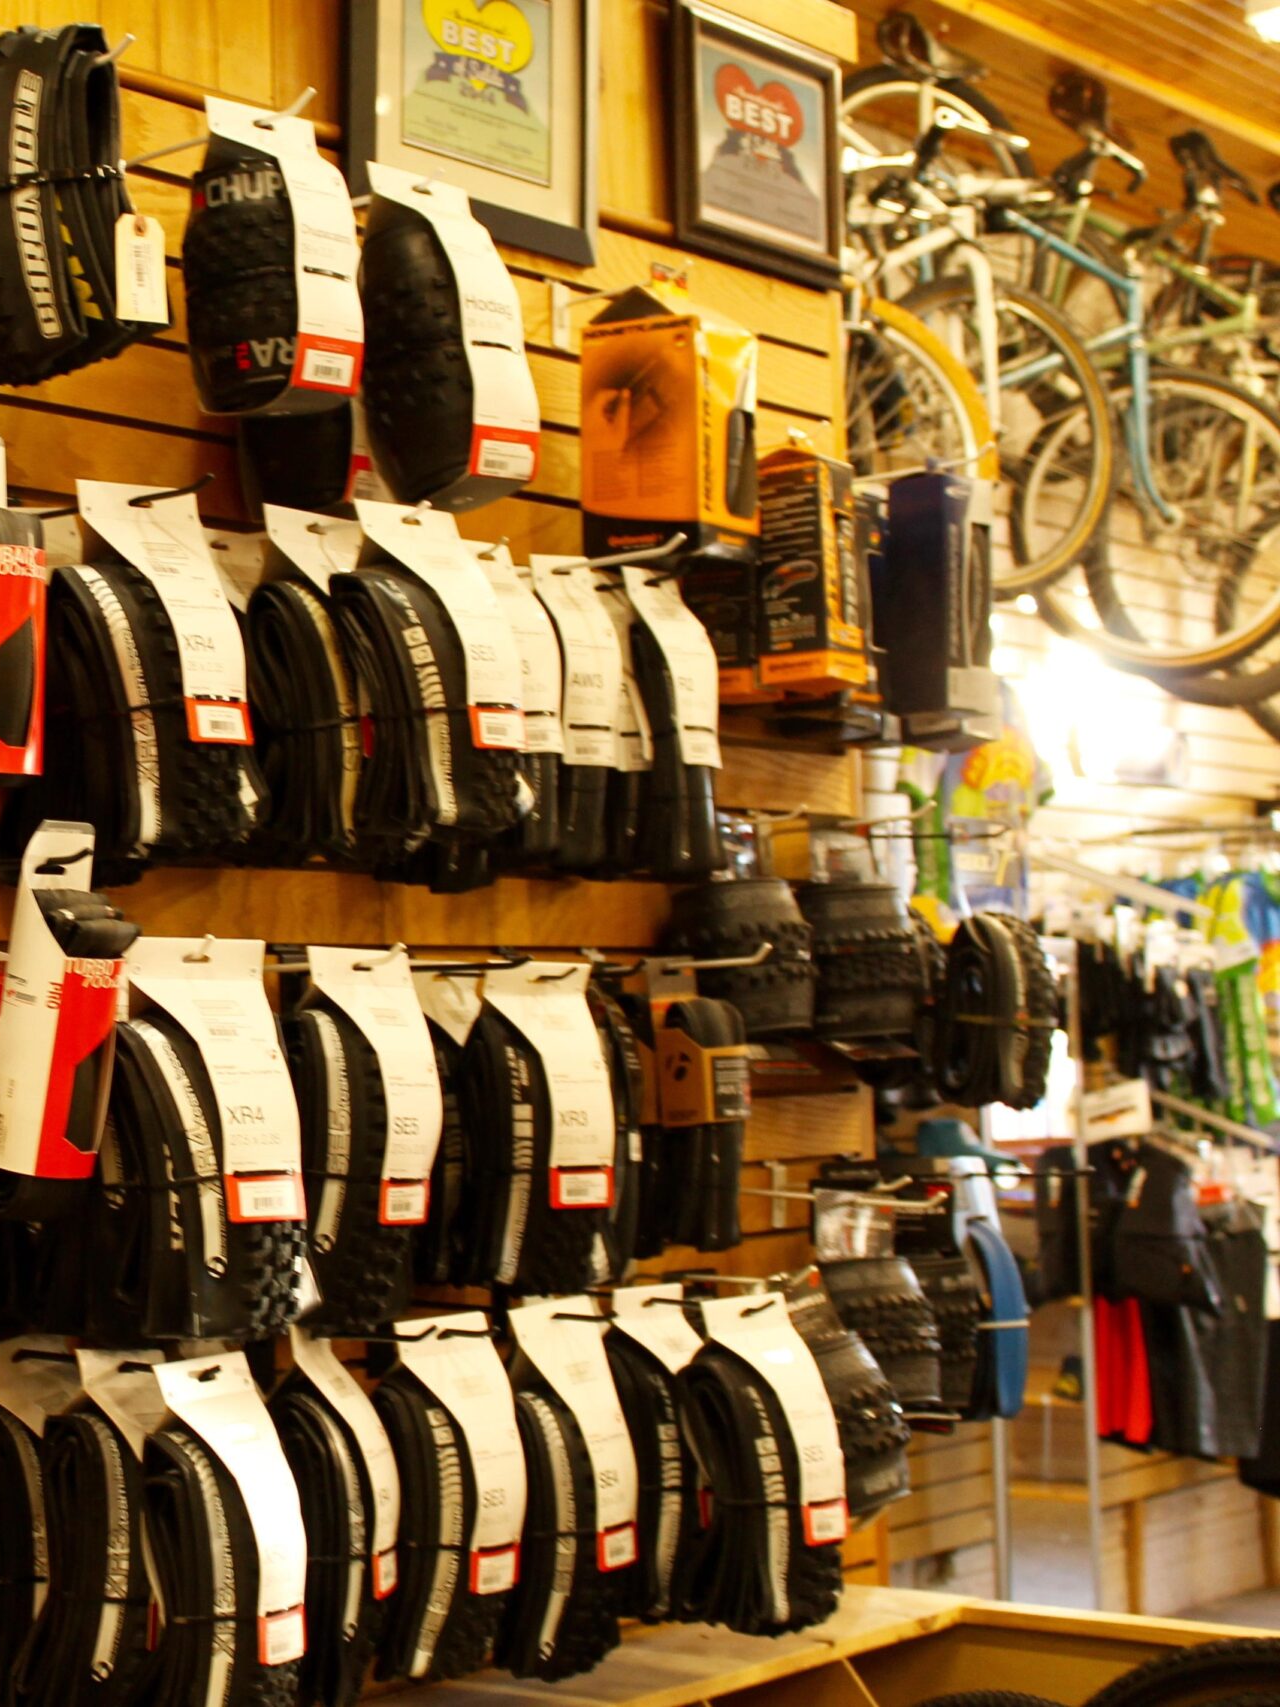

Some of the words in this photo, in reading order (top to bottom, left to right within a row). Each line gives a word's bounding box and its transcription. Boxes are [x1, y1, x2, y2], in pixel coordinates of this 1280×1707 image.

[441, 19, 517, 63] BEST
[725, 93, 793, 140] BEST
[204, 170, 288, 208] CHUP
[131, 711, 161, 786] XR4
[65, 958, 115, 976] TURBO
[227, 1105, 265, 1125] XR4
[184, 1124, 221, 1198] XR4
